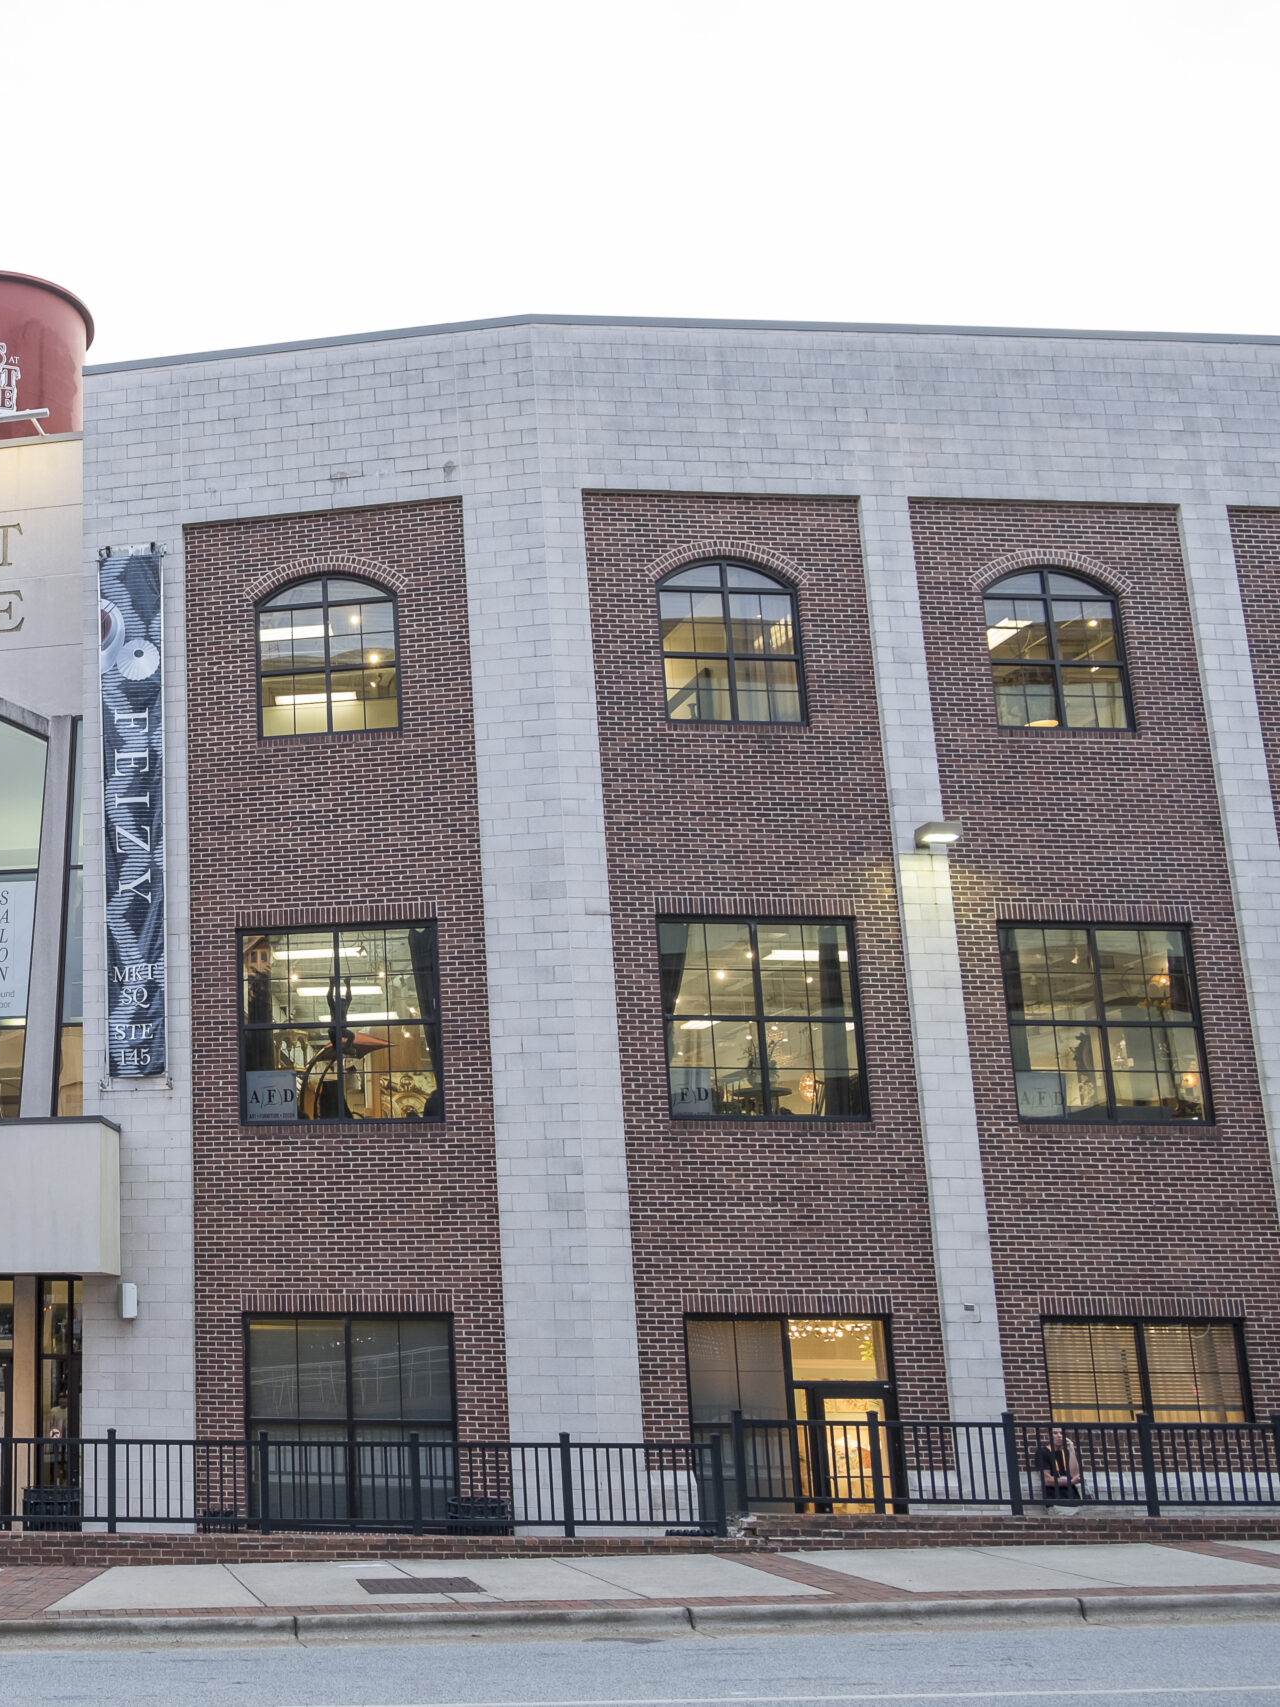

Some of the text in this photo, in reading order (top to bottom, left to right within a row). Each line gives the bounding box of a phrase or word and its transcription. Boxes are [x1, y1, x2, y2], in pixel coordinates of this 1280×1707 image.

[9, 356, 20, 364] AT
[113, 707, 152, 904] FEIZY
[113, 963, 158, 983] MKT
[121, 987, 150, 1008] SQ
[115, 1023, 154, 1041] STE
[120, 1048, 151, 1066] 145
